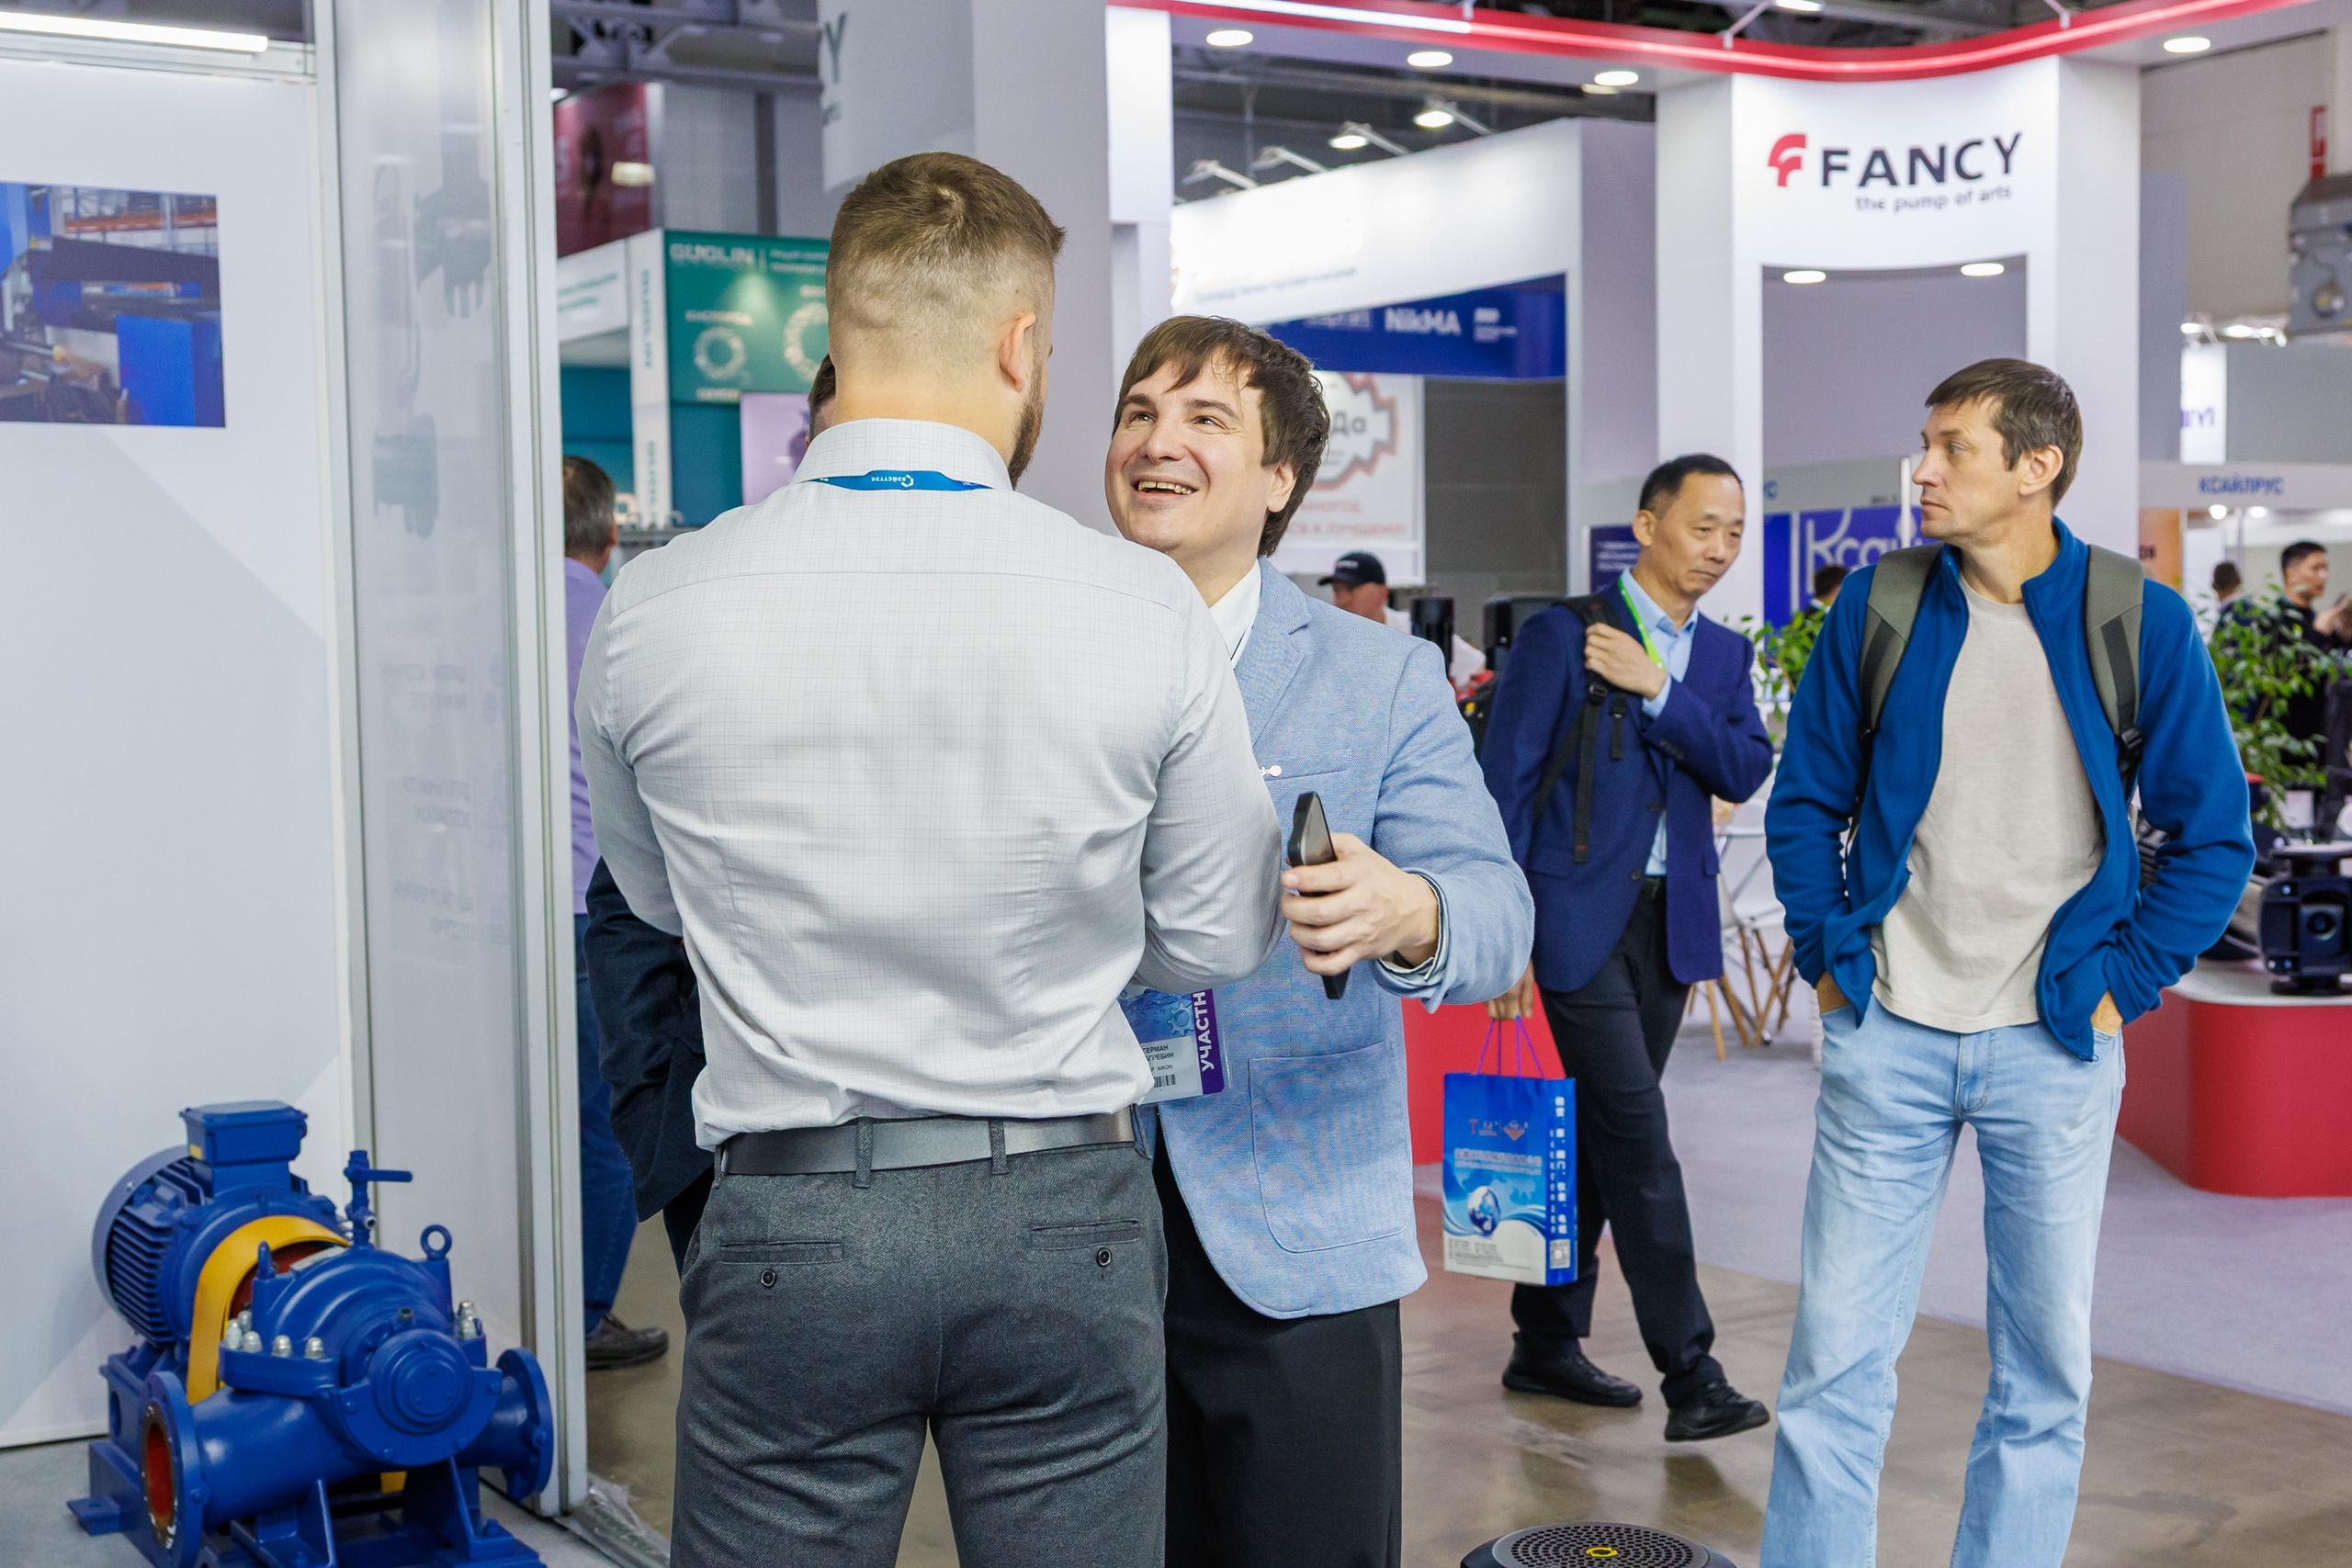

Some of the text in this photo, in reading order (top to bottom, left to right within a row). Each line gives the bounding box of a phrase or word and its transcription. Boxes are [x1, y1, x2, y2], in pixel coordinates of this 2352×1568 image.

[1822, 131, 2022, 186] FANCY
[1856, 185, 2013, 213] the pump of arts
